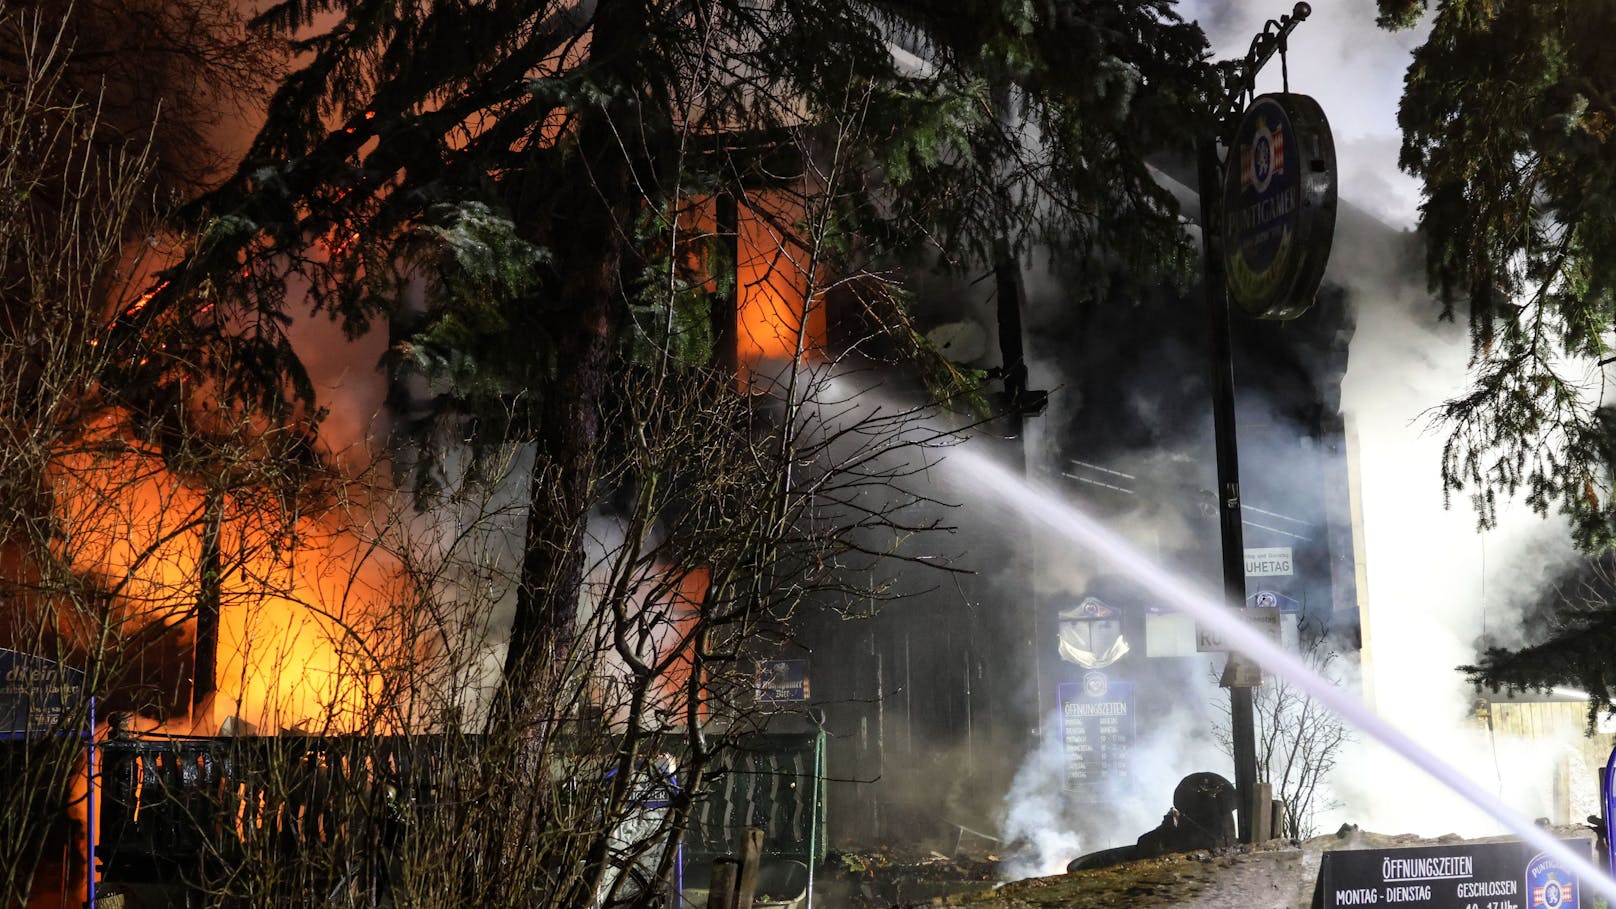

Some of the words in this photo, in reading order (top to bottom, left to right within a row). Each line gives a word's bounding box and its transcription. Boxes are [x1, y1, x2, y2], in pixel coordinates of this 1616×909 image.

[1246, 561, 1290, 572] UHETAG
[1065, 702, 1127, 715] ÖFFNUNGSZEITEN
[1383, 856, 1473, 879] ÖFFNUNGSZEITEN
[1336, 888, 1378, 905] MONTAG
[1386, 885, 1431, 903] DIENSTAG
[1457, 880, 1517, 898] GESCHLOSSEN
